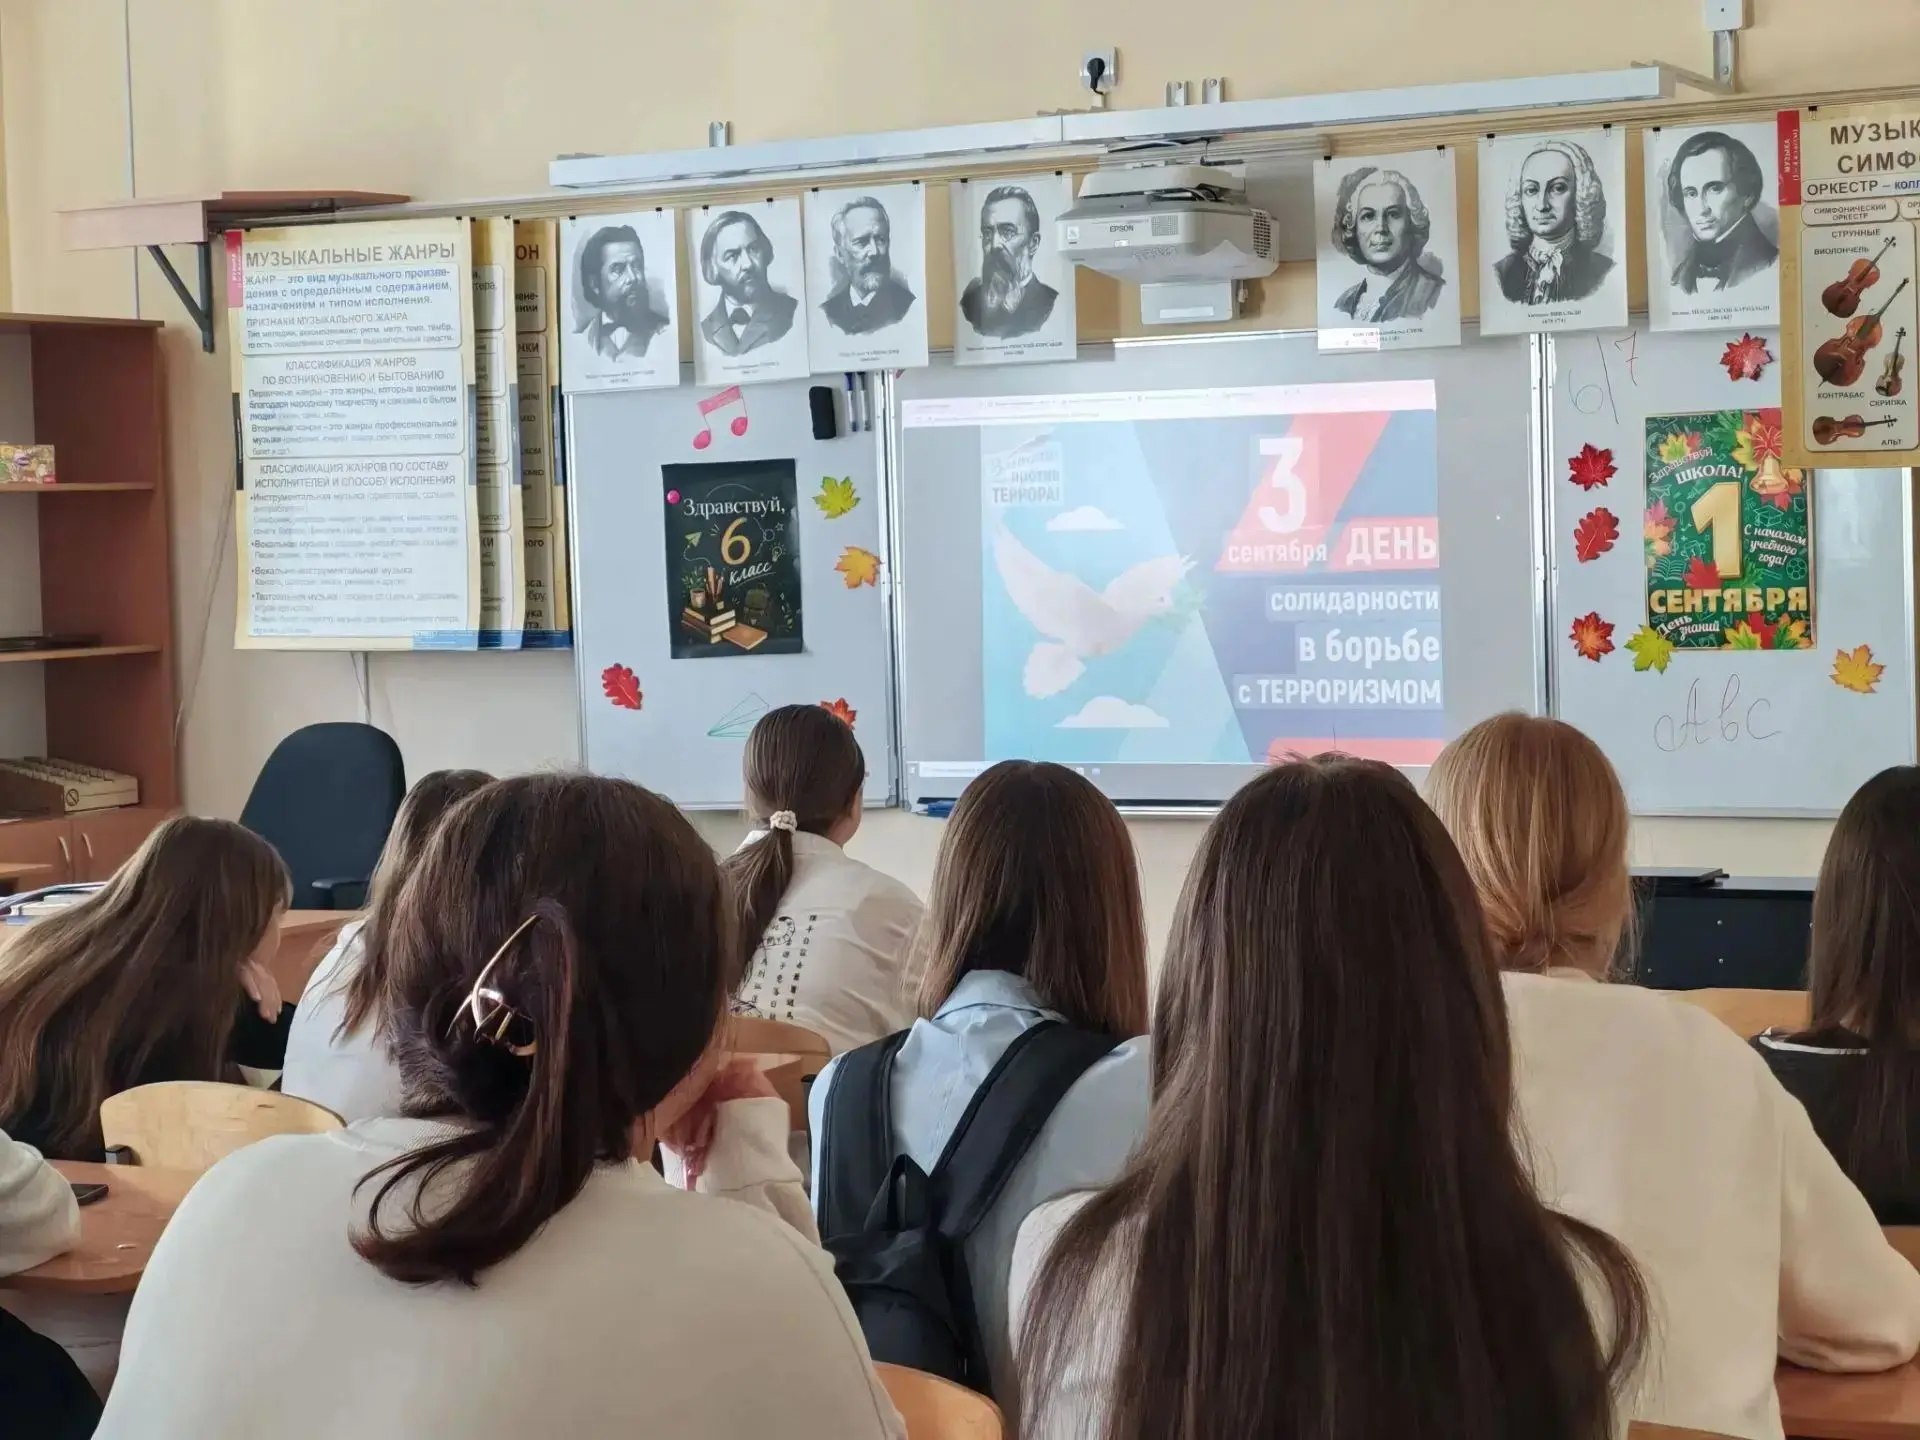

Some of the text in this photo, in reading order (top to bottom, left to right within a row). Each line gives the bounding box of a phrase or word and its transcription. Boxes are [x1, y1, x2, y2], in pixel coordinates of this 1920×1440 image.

[1837, 150, 1920, 174] СИМФ
[1807, 180, 1878, 196] ОРКЕСТР
[1813, 203, 1887, 215] СИМФОНИЧЕСКИЙ
[1832, 213, 1869, 222] ОРКЕСТР
[1109, 225, 1134, 233] EPSON
[1831, 228, 1881, 239] СТРУННЫЕ
[245, 242, 455, 268] МУЗЫКАЛЬНЫЕ ЖАНРЫ
[1813, 246, 1870, 256] ВИОЛОНЧЕЛЬ
[245, 268, 451, 285] ЖАНР это вид музыкального произве-
[245, 281, 452, 299] дения с определенным содержанием,
[246, 301, 315, 311] назначением
[328, 299, 362, 308] типом
[365, 296, 433, 306] исполнения.
[246, 311, 408, 327] ПРИЗНАКИ МУЗЫКАЛЬНОГО ЖАНРА
[285, 356, 417, 370] КЛАССИФИКАЦИЯ ЖАНРОВ
[262, 370, 445, 385] ПО ВОЗНИКНОВЕНИЮ И БЫТОВАНИЮ
[1817, 391, 1866, 399] КОНТРАБАС
[259, 460, 449, 474] КЛАССИФИКАЦИЯ ЖАНРОВ ПО СОСТАВУ
[1674, 463, 1744, 486] ШКОЛА!
[255, 474, 456, 488] ИСПОЛНИТЕЛЕЙ И СПОСОБУ ИСПОЛНЕНИЯ
[1257, 436, 1307, 534] 3
[683, 496, 786, 520] Здравствуй,
[1690, 481, 1744, 579] 1
[1743, 523, 1808, 546] С началом
[720, 516, 751, 566] 6
[1227, 524, 1438, 567] сентября ДЕНЬ
[1750, 539, 1798, 556] учебного
[1757, 554, 1788, 568] года!
[1270, 589, 1439, 617] солидарности
[1649, 586, 1808, 614] СЕНТЯБРЯ
[1656, 614, 1693, 639] День
[1678, 620, 1721, 641] знаний
[1299, 627, 1441, 670] в борьбе
[1237, 678, 1442, 705] с ТЕРРОРИЗМОМ
